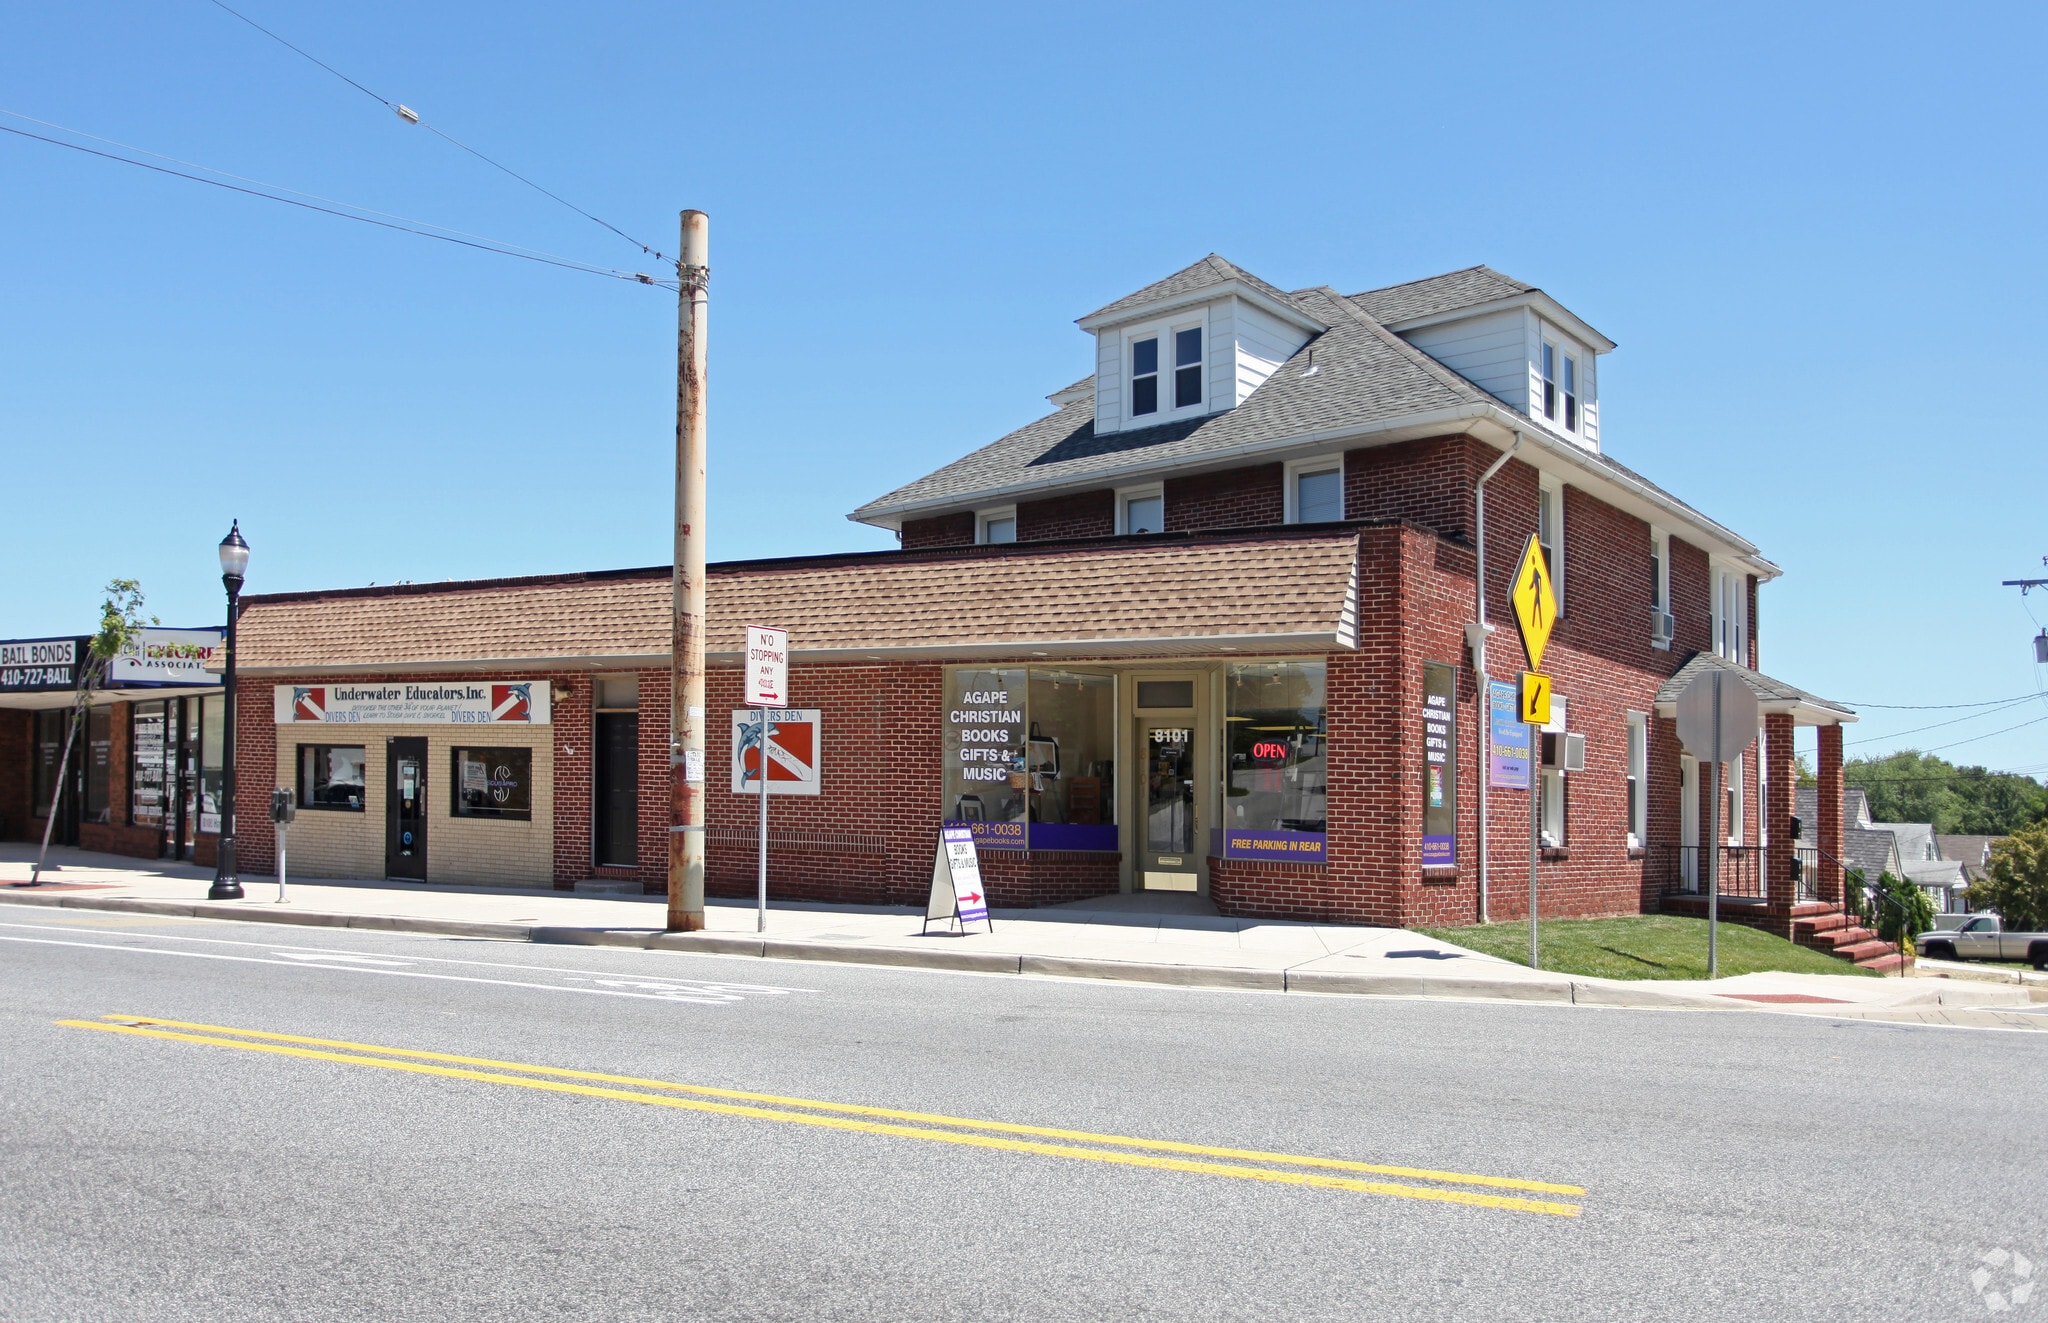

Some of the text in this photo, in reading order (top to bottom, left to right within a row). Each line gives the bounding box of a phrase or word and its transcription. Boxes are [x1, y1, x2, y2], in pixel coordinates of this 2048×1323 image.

[760, 633, 774, 646] NO
[2, 643, 72, 665] BAIL BONDS
[750, 648, 784, 664] STOPPING
[147, 660, 205, 670] ASSOCIAT
[760, 665, 774, 676] ANY
[1, 667, 72, 686] 410-727-BAIL
[334, 686, 401, 701] Underwater
[963, 691, 1008, 704] AGAPE
[1427, 694, 1446, 707] AGAPE
[325, 711, 361, 723] DIVERS DEN
[451, 711, 492, 723] DIVERS DEN
[750, 710, 803, 722] DIVRS DEN
[950, 710, 1021, 723] CHRISTIAN
[1422, 708, 1451, 722] CHRISTIAN
[1426, 722, 1447, 735] BOOKS
[961, 729, 1009, 742] BOOKS
[1154, 729, 1189, 743] 8101
[1426, 736, 1447, 749] GIFTS &
[960, 748, 1011, 762] GIFTS &
[1253, 742, 1287, 759] OPEN
[1427, 751, 1446, 763] MUSIC
[963, 767, 1007, 781] MUSIC
[1231, 838, 1322, 852] FREE PARKING IN REAR
